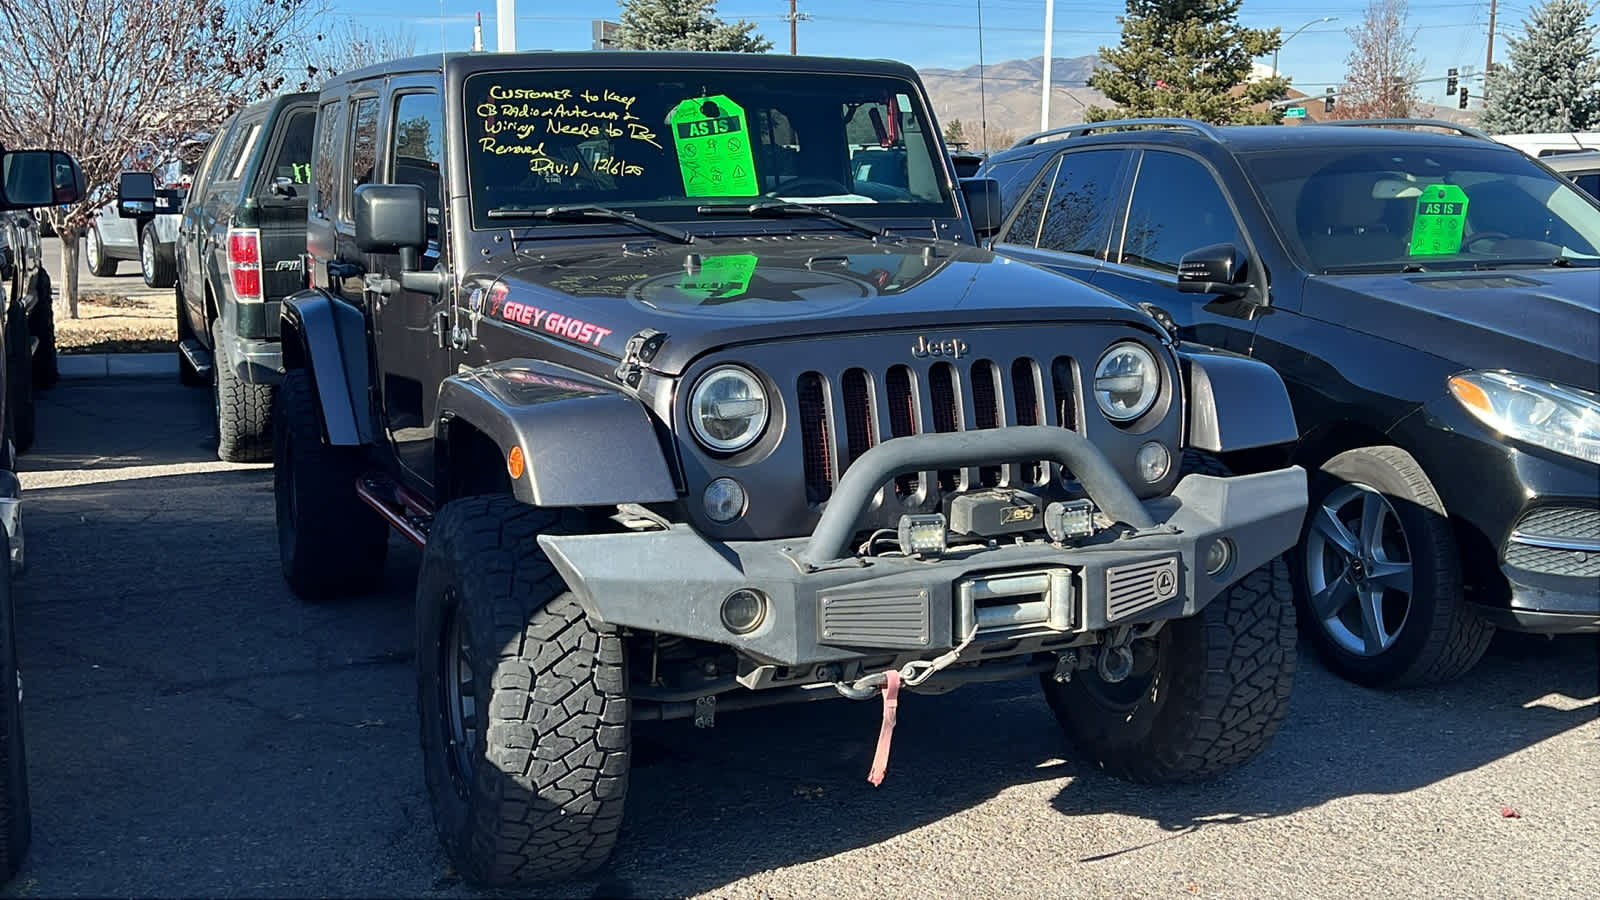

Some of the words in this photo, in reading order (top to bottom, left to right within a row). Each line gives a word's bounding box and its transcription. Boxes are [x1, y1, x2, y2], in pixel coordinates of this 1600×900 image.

[580, 89, 599, 103] to
[604, 89, 636, 110] Keep
[477, 103, 497, 117] CB
[484, 119, 535, 139] Wiring
[546, 118, 600, 138] Needs
[606, 122, 623, 137] to
[627, 123, 663, 149] Be
[690, 122, 708, 136] AS
[713, 119, 729, 134] IS
[478, 137, 546, 156] Removed
[593, 156, 644, 176] 12/6/25
[1425, 203, 1440, 214] AS
[1443, 203, 1454, 214] IS
[502, 300, 548, 327] GREY
[544, 312, 613, 347] GHOST
[911, 335, 969, 360] Jeep
